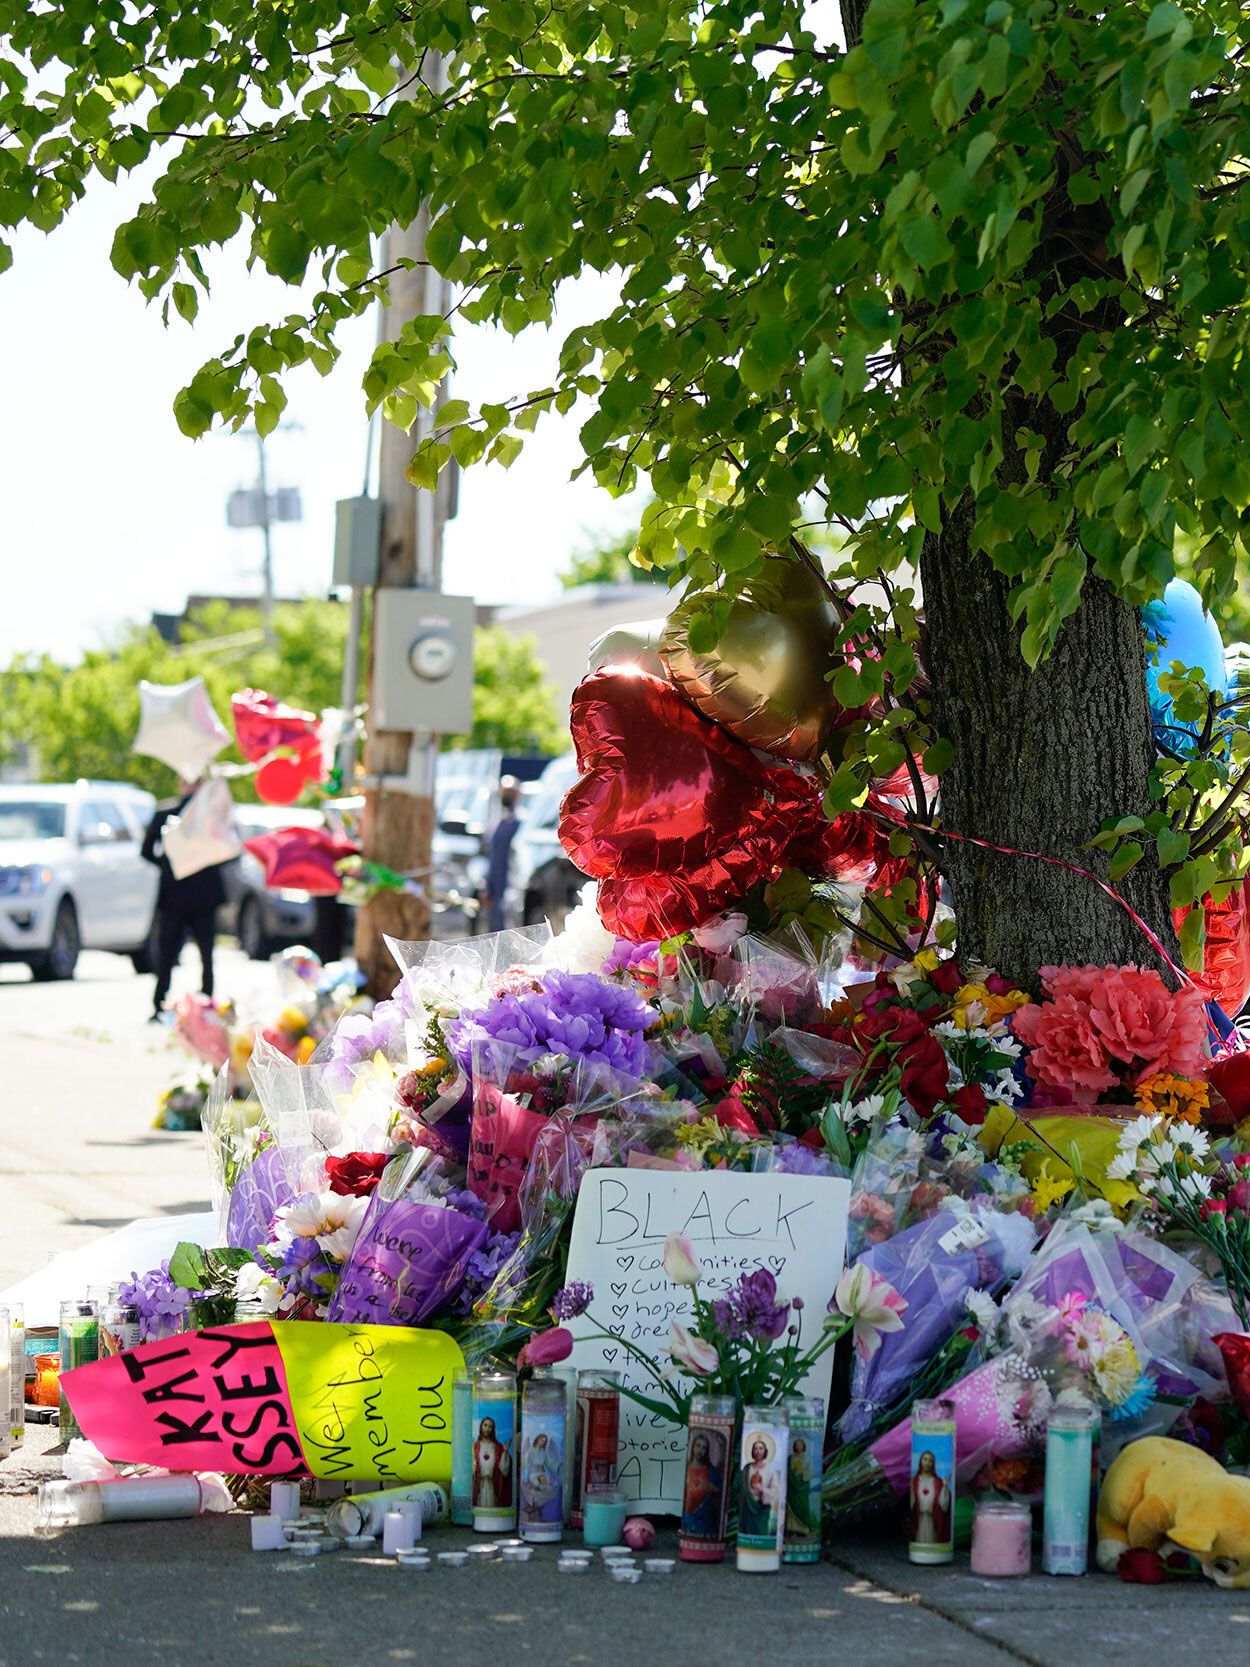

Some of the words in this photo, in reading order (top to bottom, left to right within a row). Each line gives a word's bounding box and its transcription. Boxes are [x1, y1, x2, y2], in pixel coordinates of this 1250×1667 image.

[595, 1179, 814, 1251] BLACK
[121, 1348, 223, 1446] KAT
[196, 1331, 309, 1476] SSEY
[616, 1456, 681, 1500] AT
